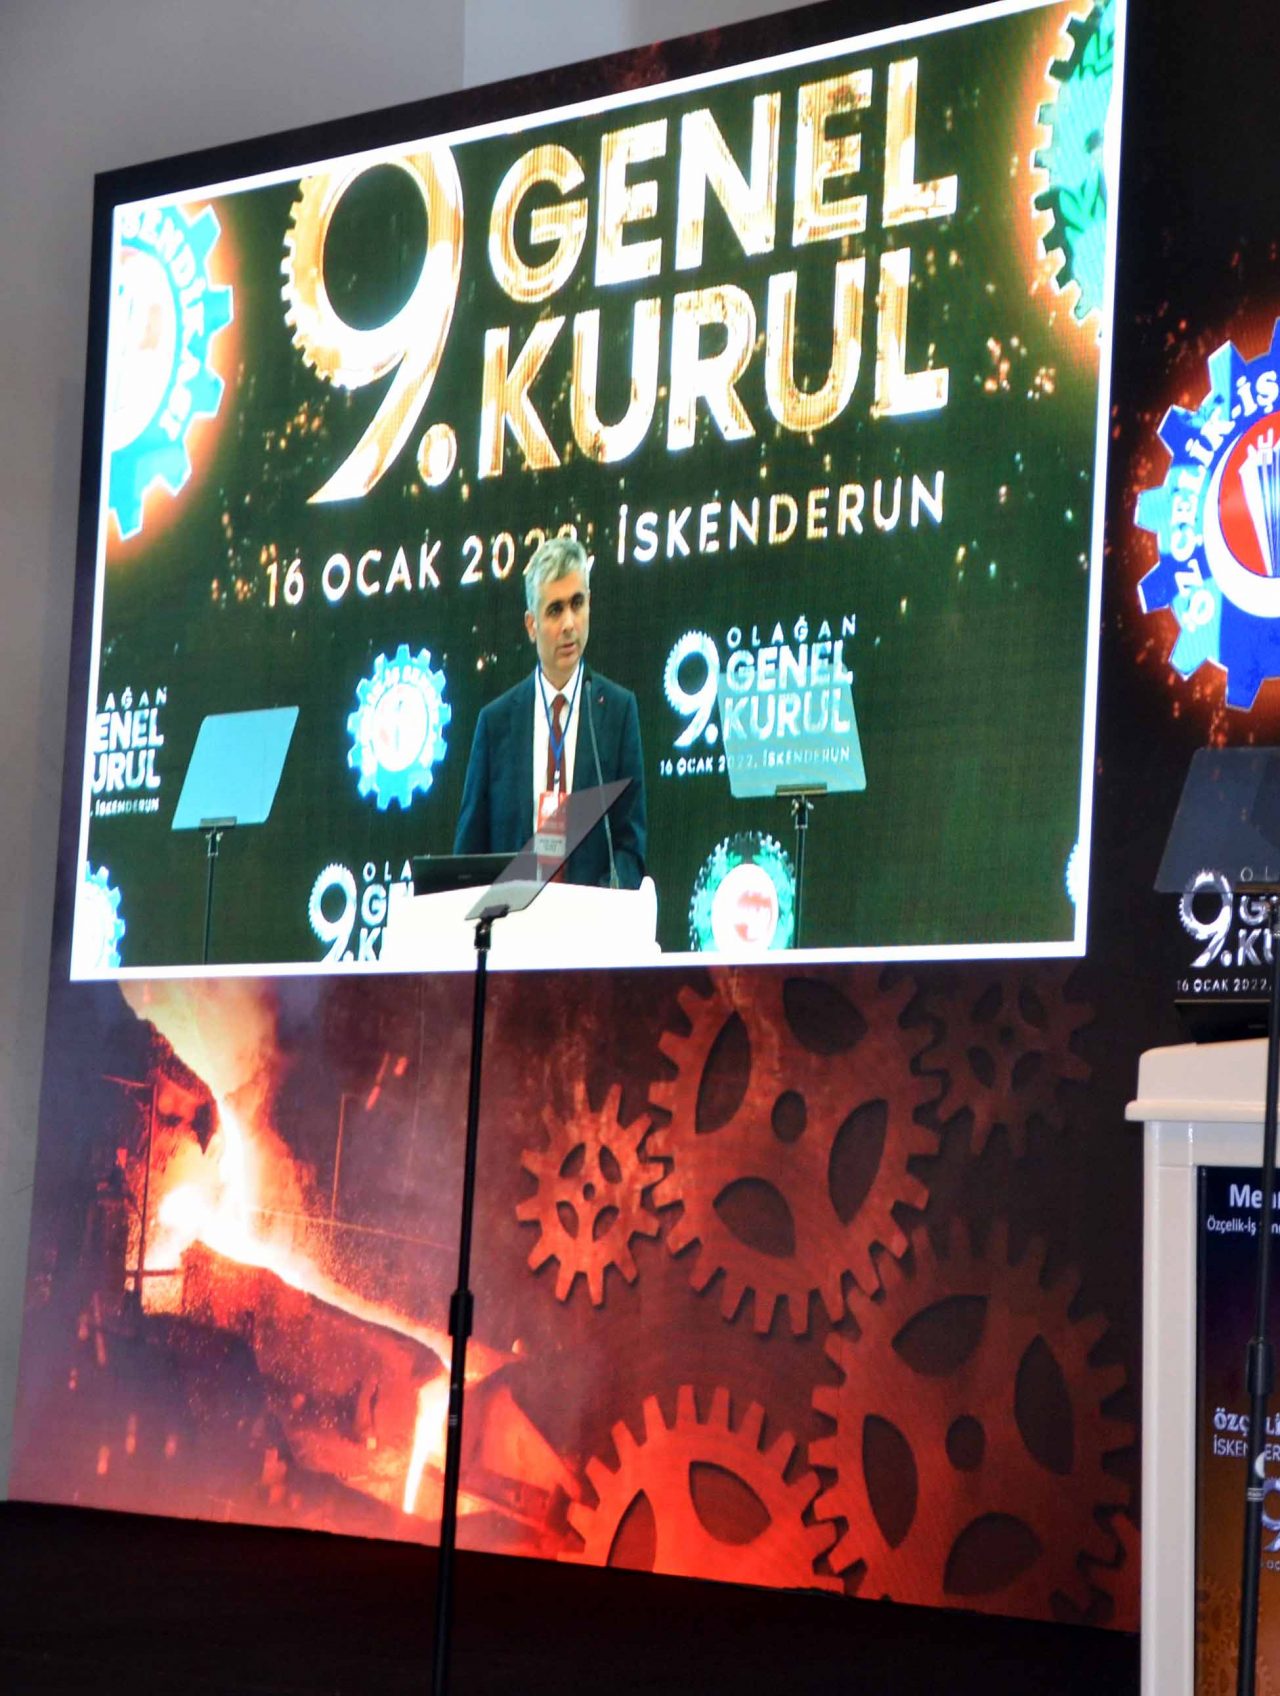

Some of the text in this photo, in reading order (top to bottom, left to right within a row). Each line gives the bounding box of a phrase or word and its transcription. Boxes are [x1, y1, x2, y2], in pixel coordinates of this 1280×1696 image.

[488, 57, 957, 303] GENEL
[281, 146, 464, 503] 9.
[477, 248, 950, 480] KURUL
[266, 557, 304, 607] 16
[321, 540, 441, 602] OCAK
[617, 470, 945, 564] İSKENDERUN
[726, 613, 857, 649] OLAĞAN
[725, 640, 854, 692] GENEL
[105, 686, 167, 711] AĞAN
[722, 687, 851, 740] KURUL
[96, 707, 164, 753] ENEL
[92, 748, 161, 794] URUL
[1207, 1215, 1257, 1236] Özçelik-İş
